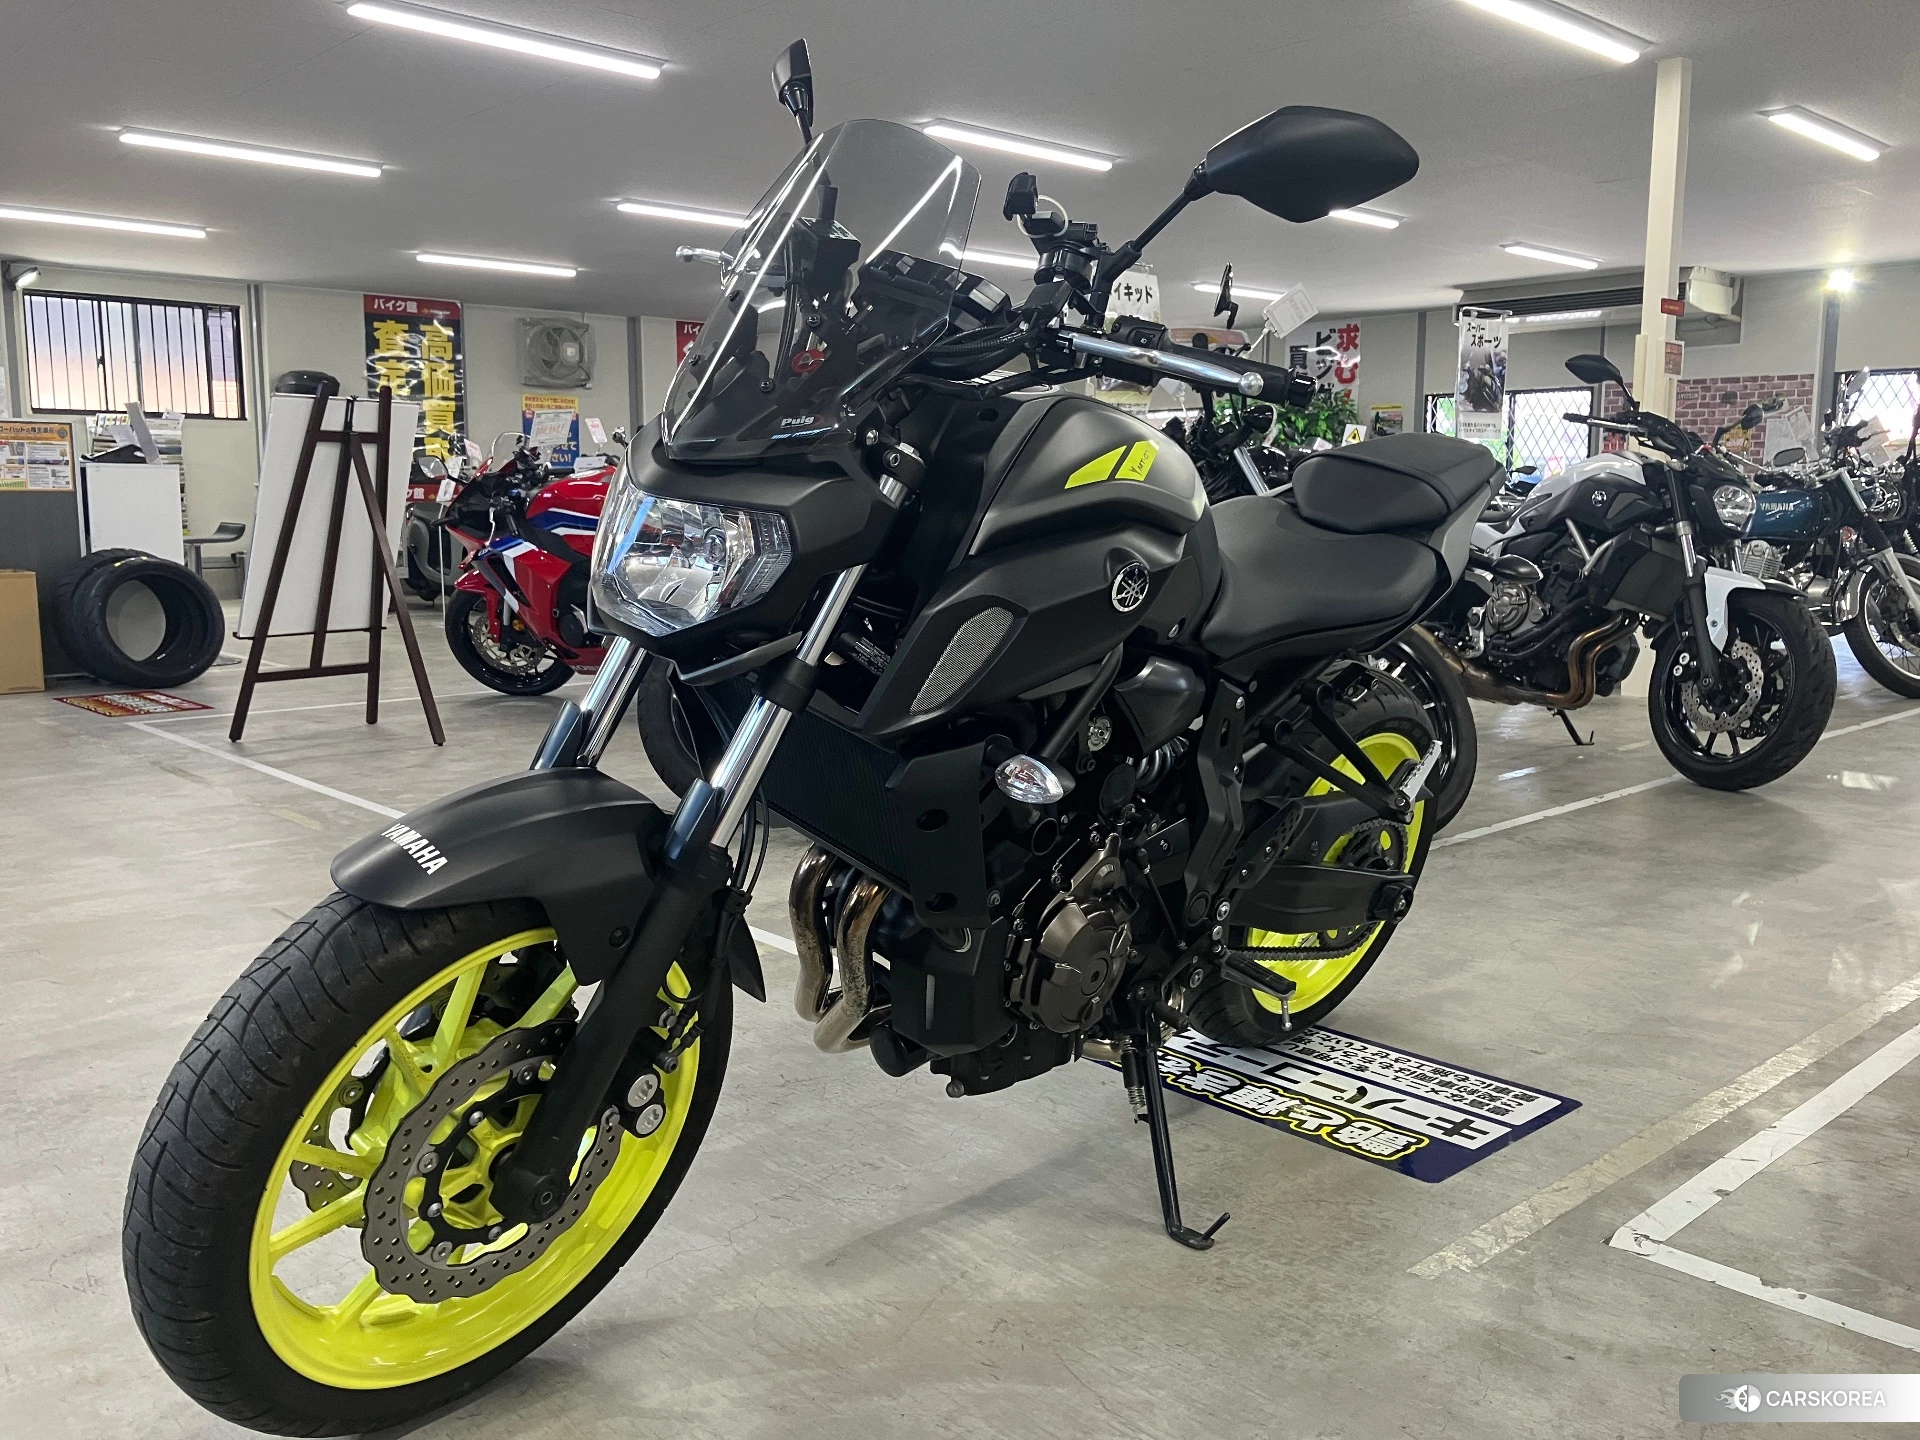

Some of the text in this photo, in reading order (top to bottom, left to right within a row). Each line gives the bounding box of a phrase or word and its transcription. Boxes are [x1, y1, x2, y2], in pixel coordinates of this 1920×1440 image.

[1110, 282, 1153, 304] イキッド
[374, 298, 418, 313] バイク館
[1471, 334, 1502, 348] スポーツ
[373, 320, 411, 396] 査定
[781, 415, 815, 426] Puig
[1760, 502, 1794, 511] YAMAHA
[381, 823, 448, 875] YAMAHA
